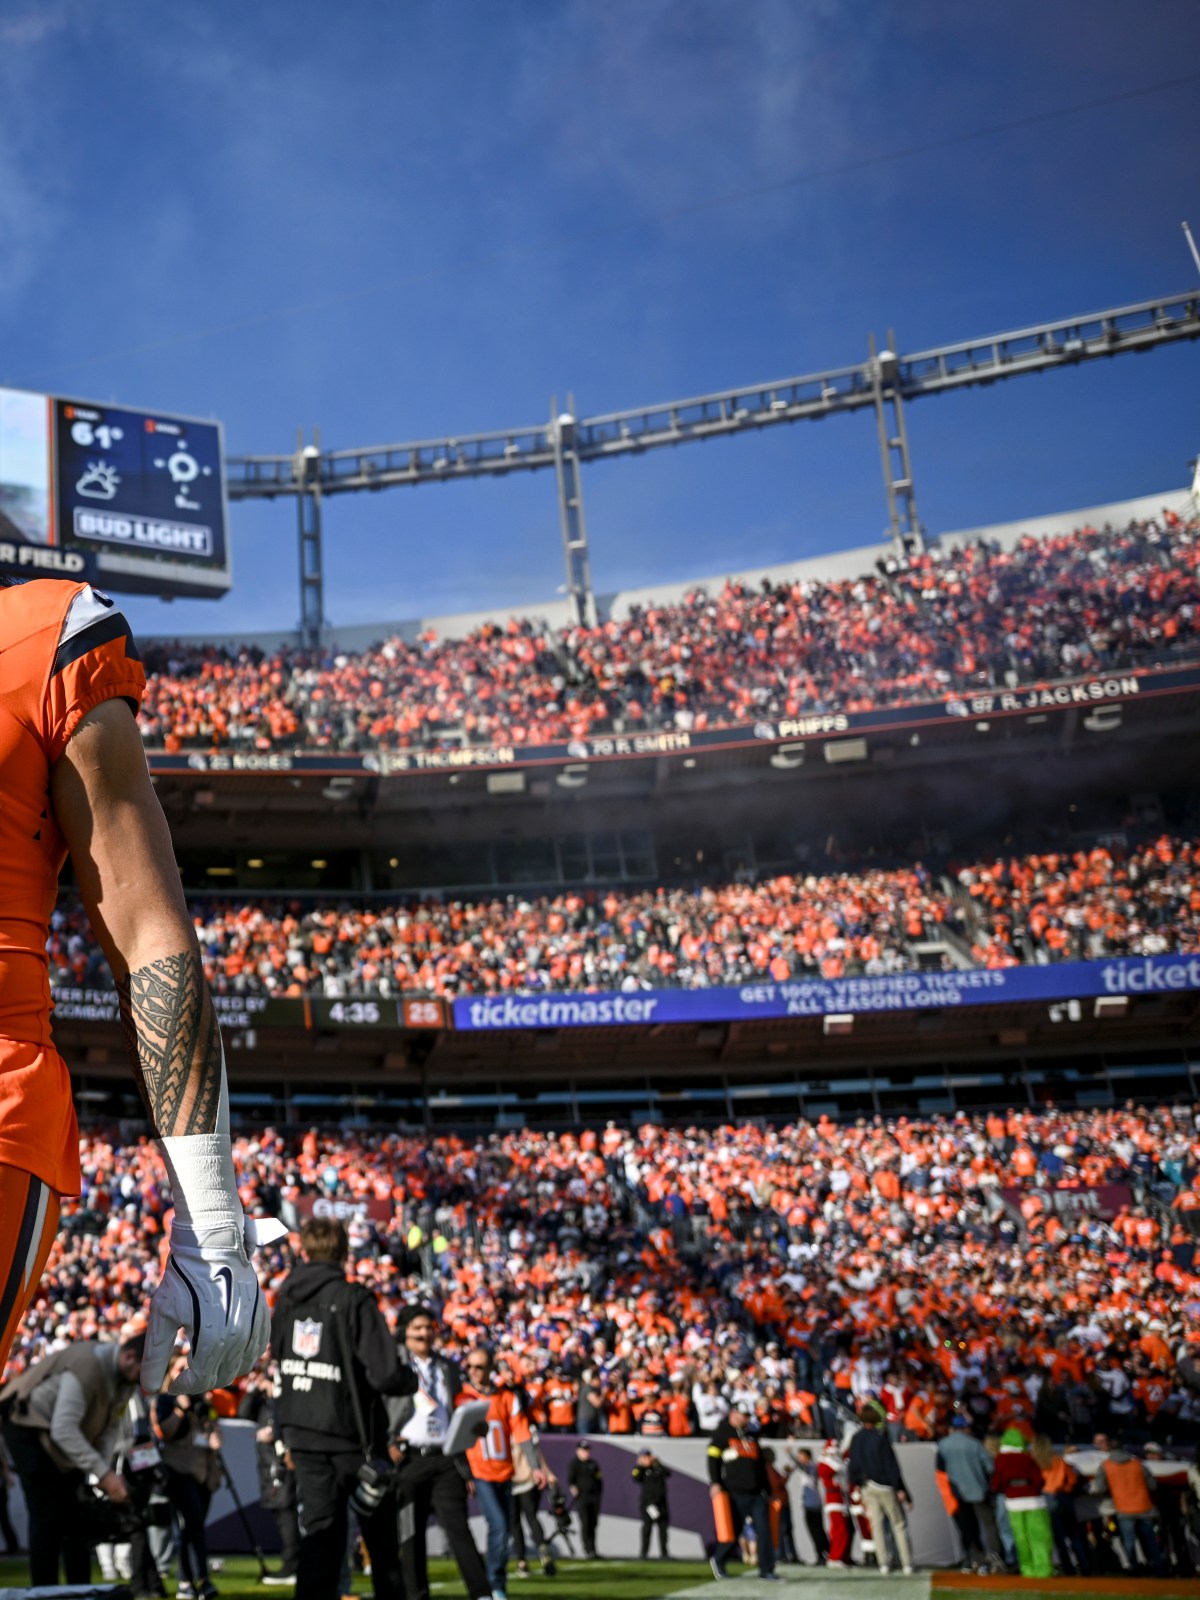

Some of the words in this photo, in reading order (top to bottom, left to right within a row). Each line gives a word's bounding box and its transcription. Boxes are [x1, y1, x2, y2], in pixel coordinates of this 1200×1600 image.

[71, 421, 124, 449] 61°
[79, 512, 133, 540] BUD
[134, 522, 206, 550] LIGHT
[19, 546, 85, 573] FIELD
[1026, 677, 1139, 708] JACKSON
[778, 714, 848, 737] PHIPPS
[633, 732, 691, 753] SMITH
[415, 747, 515, 769] THOMPSON
[740, 986, 776, 1004] GET
[780, 982, 832, 1000] 100%
[834, 976, 920, 997] VERIFIED
[923, 970, 1006, 989] TICKETS
[245, 996, 267, 1012] BY
[329, 1002, 380, 1024] 4:35
[409, 1003, 439, 1023] 25
[470, 998, 657, 1028] ticketmaster
[787, 1000, 822, 1016] ALL
[825, 994, 903, 1013] SEASON
[906, 989, 961, 1007] LONG
